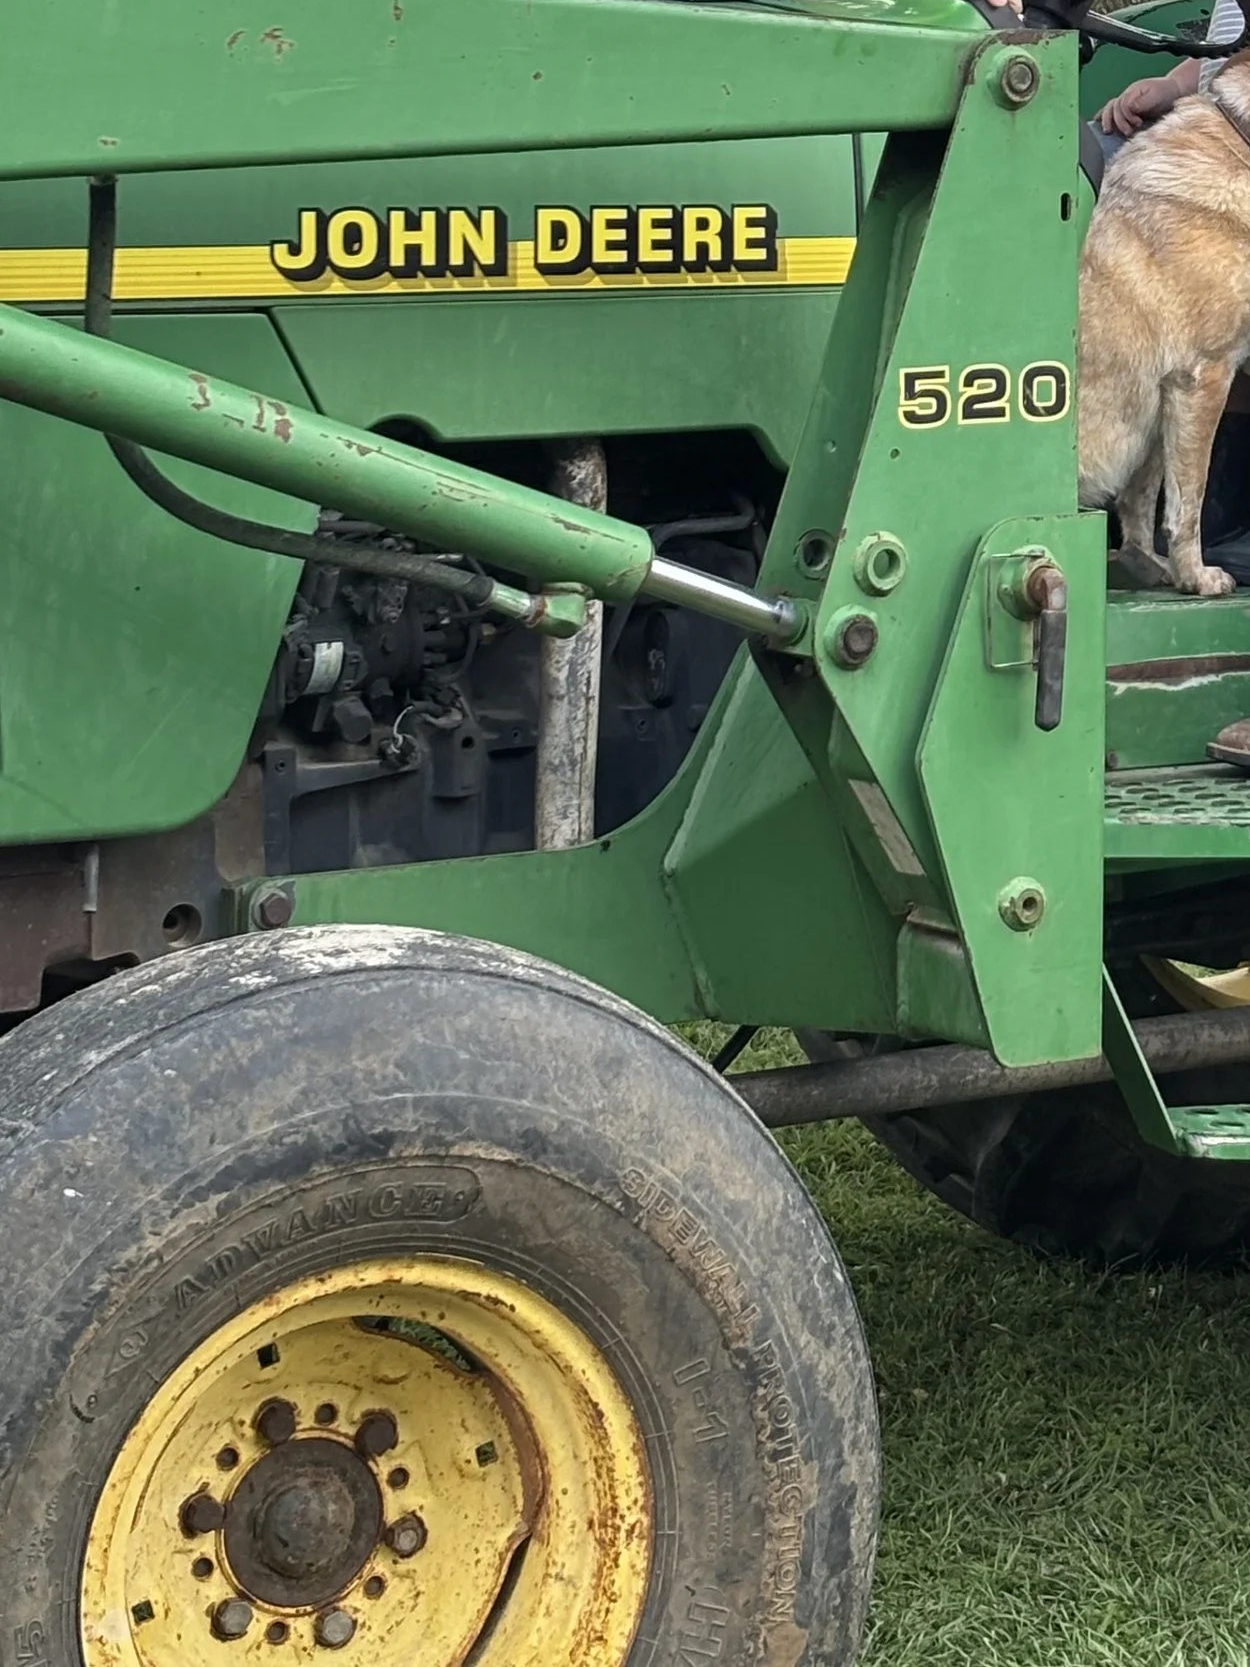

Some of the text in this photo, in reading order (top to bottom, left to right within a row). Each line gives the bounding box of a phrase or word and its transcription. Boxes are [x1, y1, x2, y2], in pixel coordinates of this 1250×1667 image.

[272, 203, 778, 280] JOHN DEERE
[897, 360, 1071, 429] 520
[173, 1181, 447, 1316] ADVANCE
[618, 1166, 803, 1626] SIDEWALL PROTECTION
